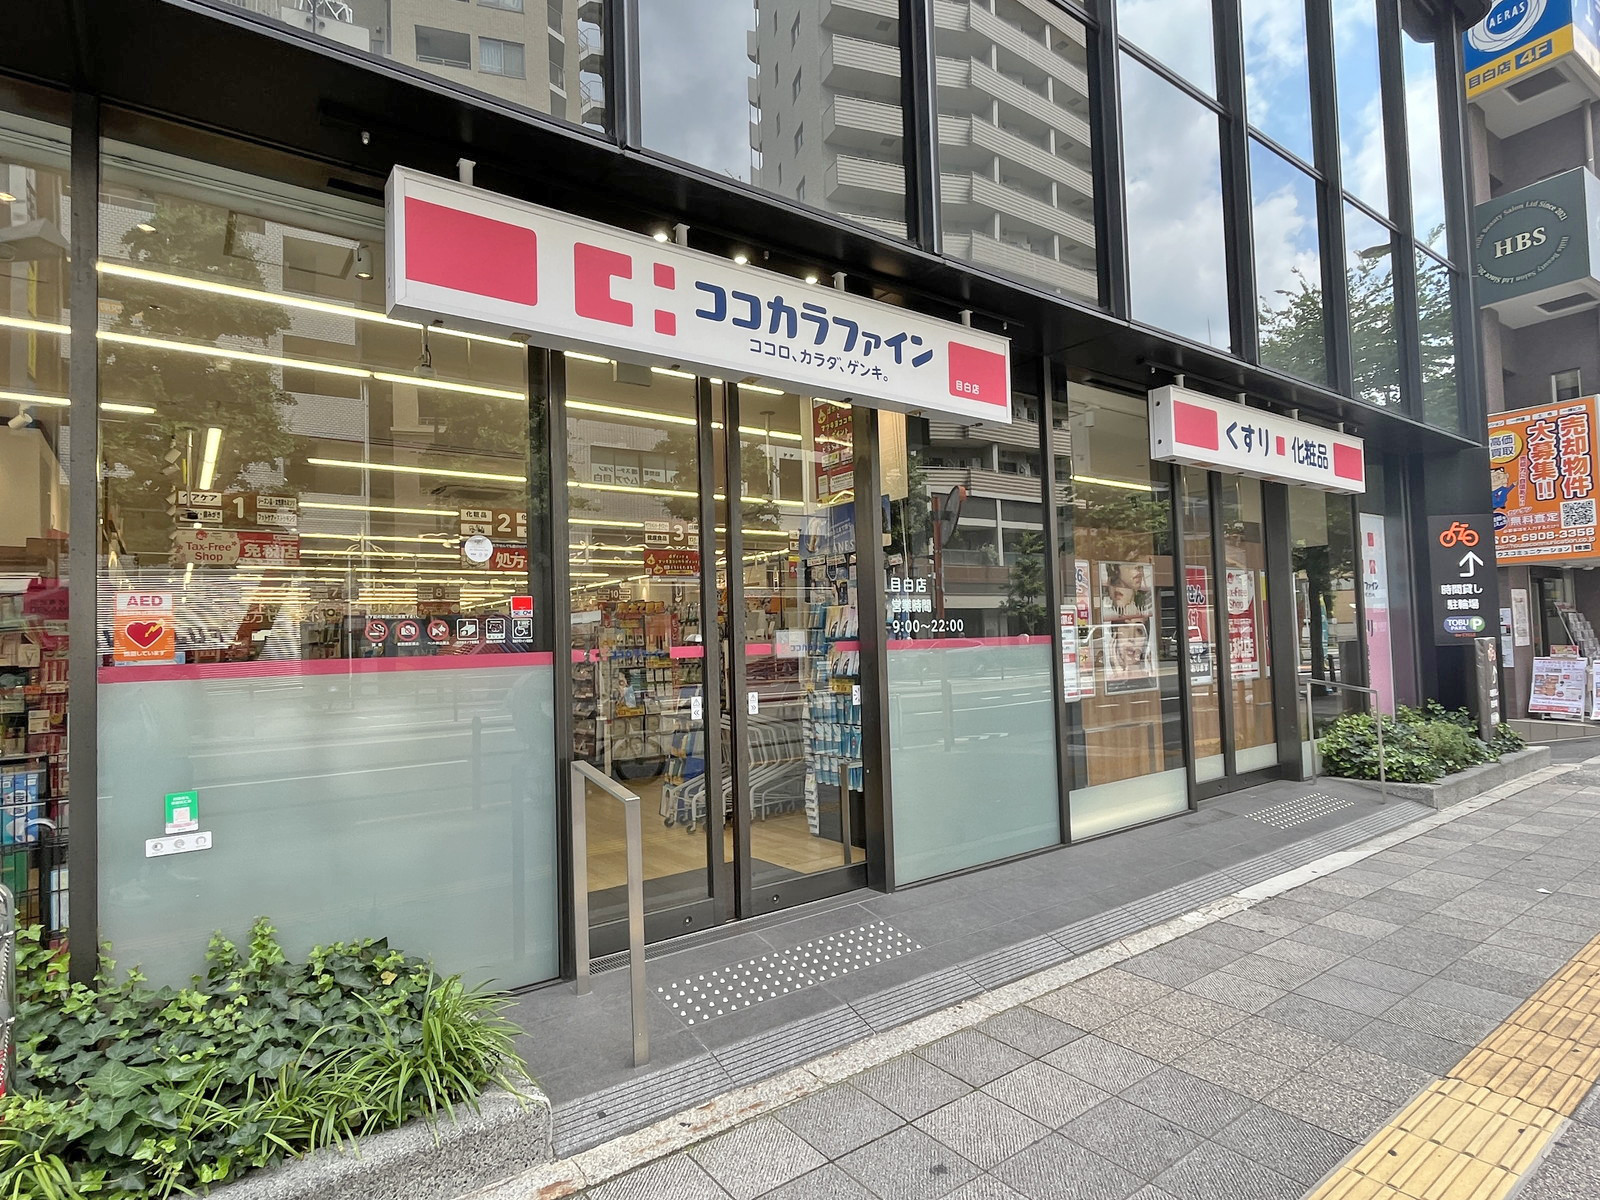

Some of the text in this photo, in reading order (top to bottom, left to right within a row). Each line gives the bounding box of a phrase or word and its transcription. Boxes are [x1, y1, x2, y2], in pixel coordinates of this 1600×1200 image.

[1489, 2, 1526, 28] AERAS
[1468, 42, 1548, 89] 目白店 4F
[1503, 203, 1524, 216] Salon
[1525, 200, 1539, 208] Ltd
[1539, 200, 1557, 212] Since
[1494, 226, 1547, 259] HBS
[694, 280, 934, 368] ココカラファイン
[749, 338, 889, 383] ココロ、カラダ、ゲンキ。
[955, 380, 980, 395] 目白店
[1226, 421, 1329, 470] くすり 化粧品
[1490, 433, 1513, 447] 高価
[1491, 446, 1514, 458] 買取
[1558, 414, 1590, 499] 売却物件
[233, 496, 244, 519] 1
[497, 513, 511, 532] 2
[1510, 512, 1559, 526] 無料査定
[673, 524, 684, 541] 3
[186, 541, 232, 552] Tax-Free
[195, 551, 223, 564] Shop
[890, 577, 927, 593] 目白店
[1440, 583, 1483, 596] 時間貸し
[435, 588, 442, 598] 8
[610, 590, 619, 598] 10
[127, 595, 163, 607] AED
[892, 598, 932, 613] 営業時間
[1446, 598, 1480, 610] 駐輪場
[1447, 618, 1483, 631] TOBU P
